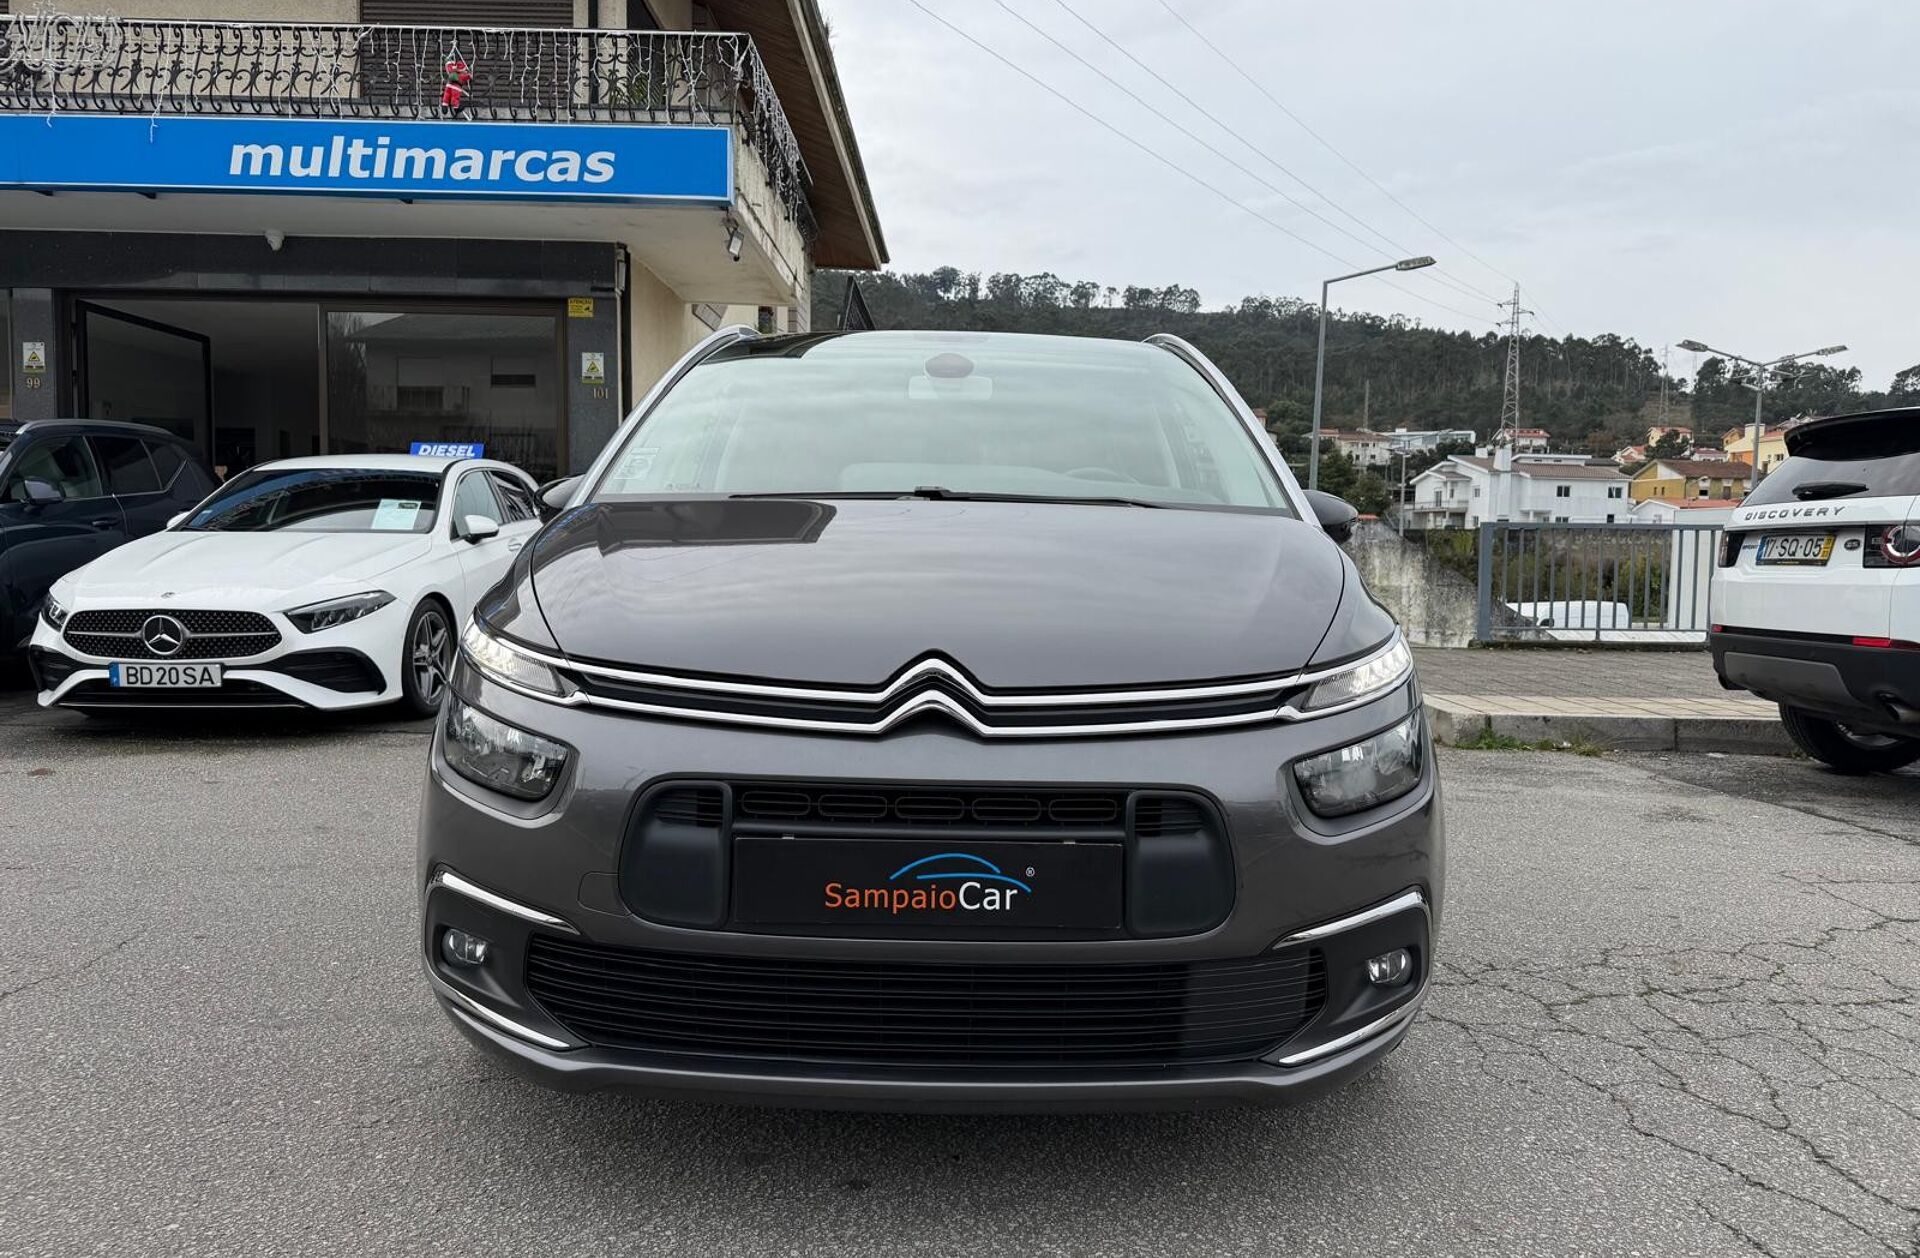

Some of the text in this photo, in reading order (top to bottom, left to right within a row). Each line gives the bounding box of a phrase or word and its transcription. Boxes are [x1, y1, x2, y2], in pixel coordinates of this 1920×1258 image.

[229, 135, 615, 184] multimarcas
[593, 386, 608, 400] 101
[418, 444, 476, 457] DIESEL
[1745, 506, 1846, 521] DISCOVERY
[824, 881, 1018, 915] SampaioCar
